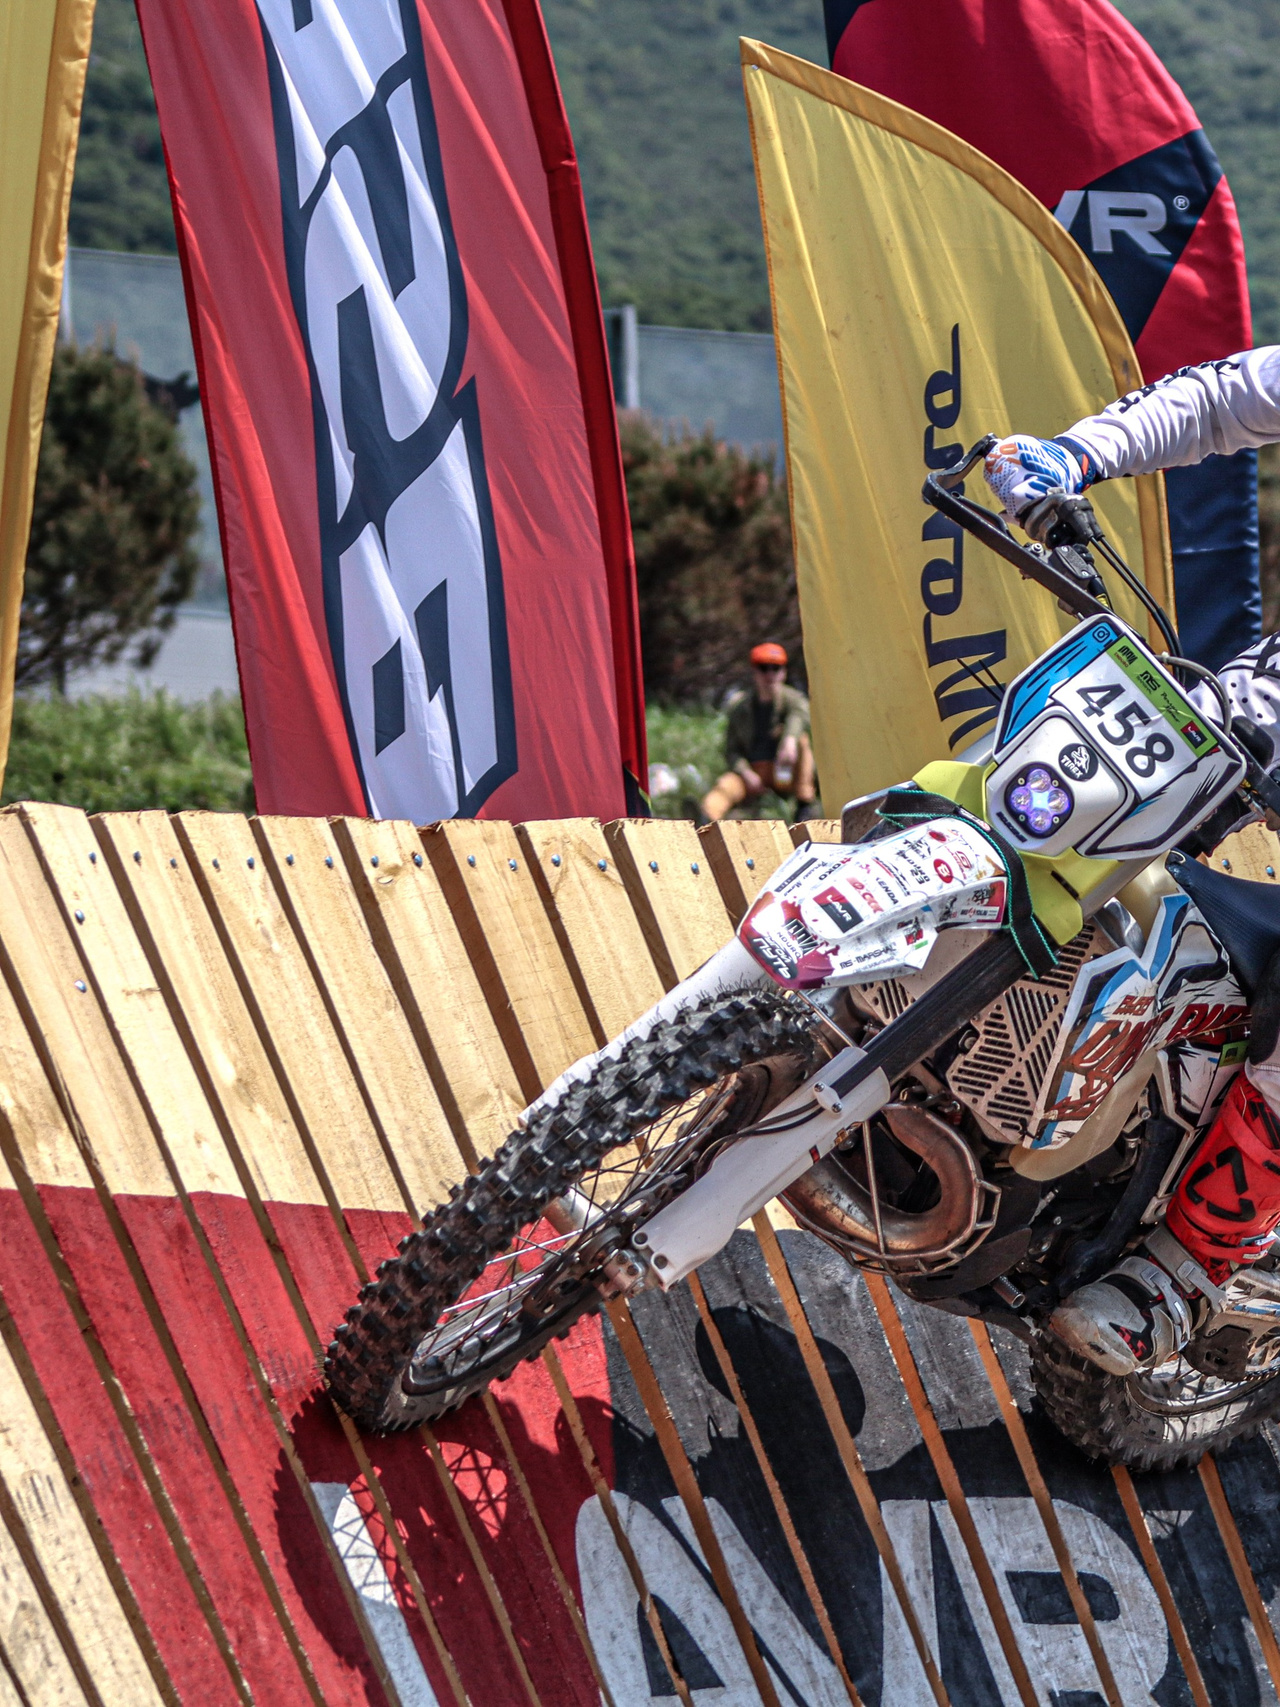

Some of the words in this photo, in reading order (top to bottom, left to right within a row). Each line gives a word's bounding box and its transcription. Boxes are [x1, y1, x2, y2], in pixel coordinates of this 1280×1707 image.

[1076, 683, 1174, 777] 458
[826, 894, 854, 922] LAVR
[753, 938, 792, 980] ПУТЬ
